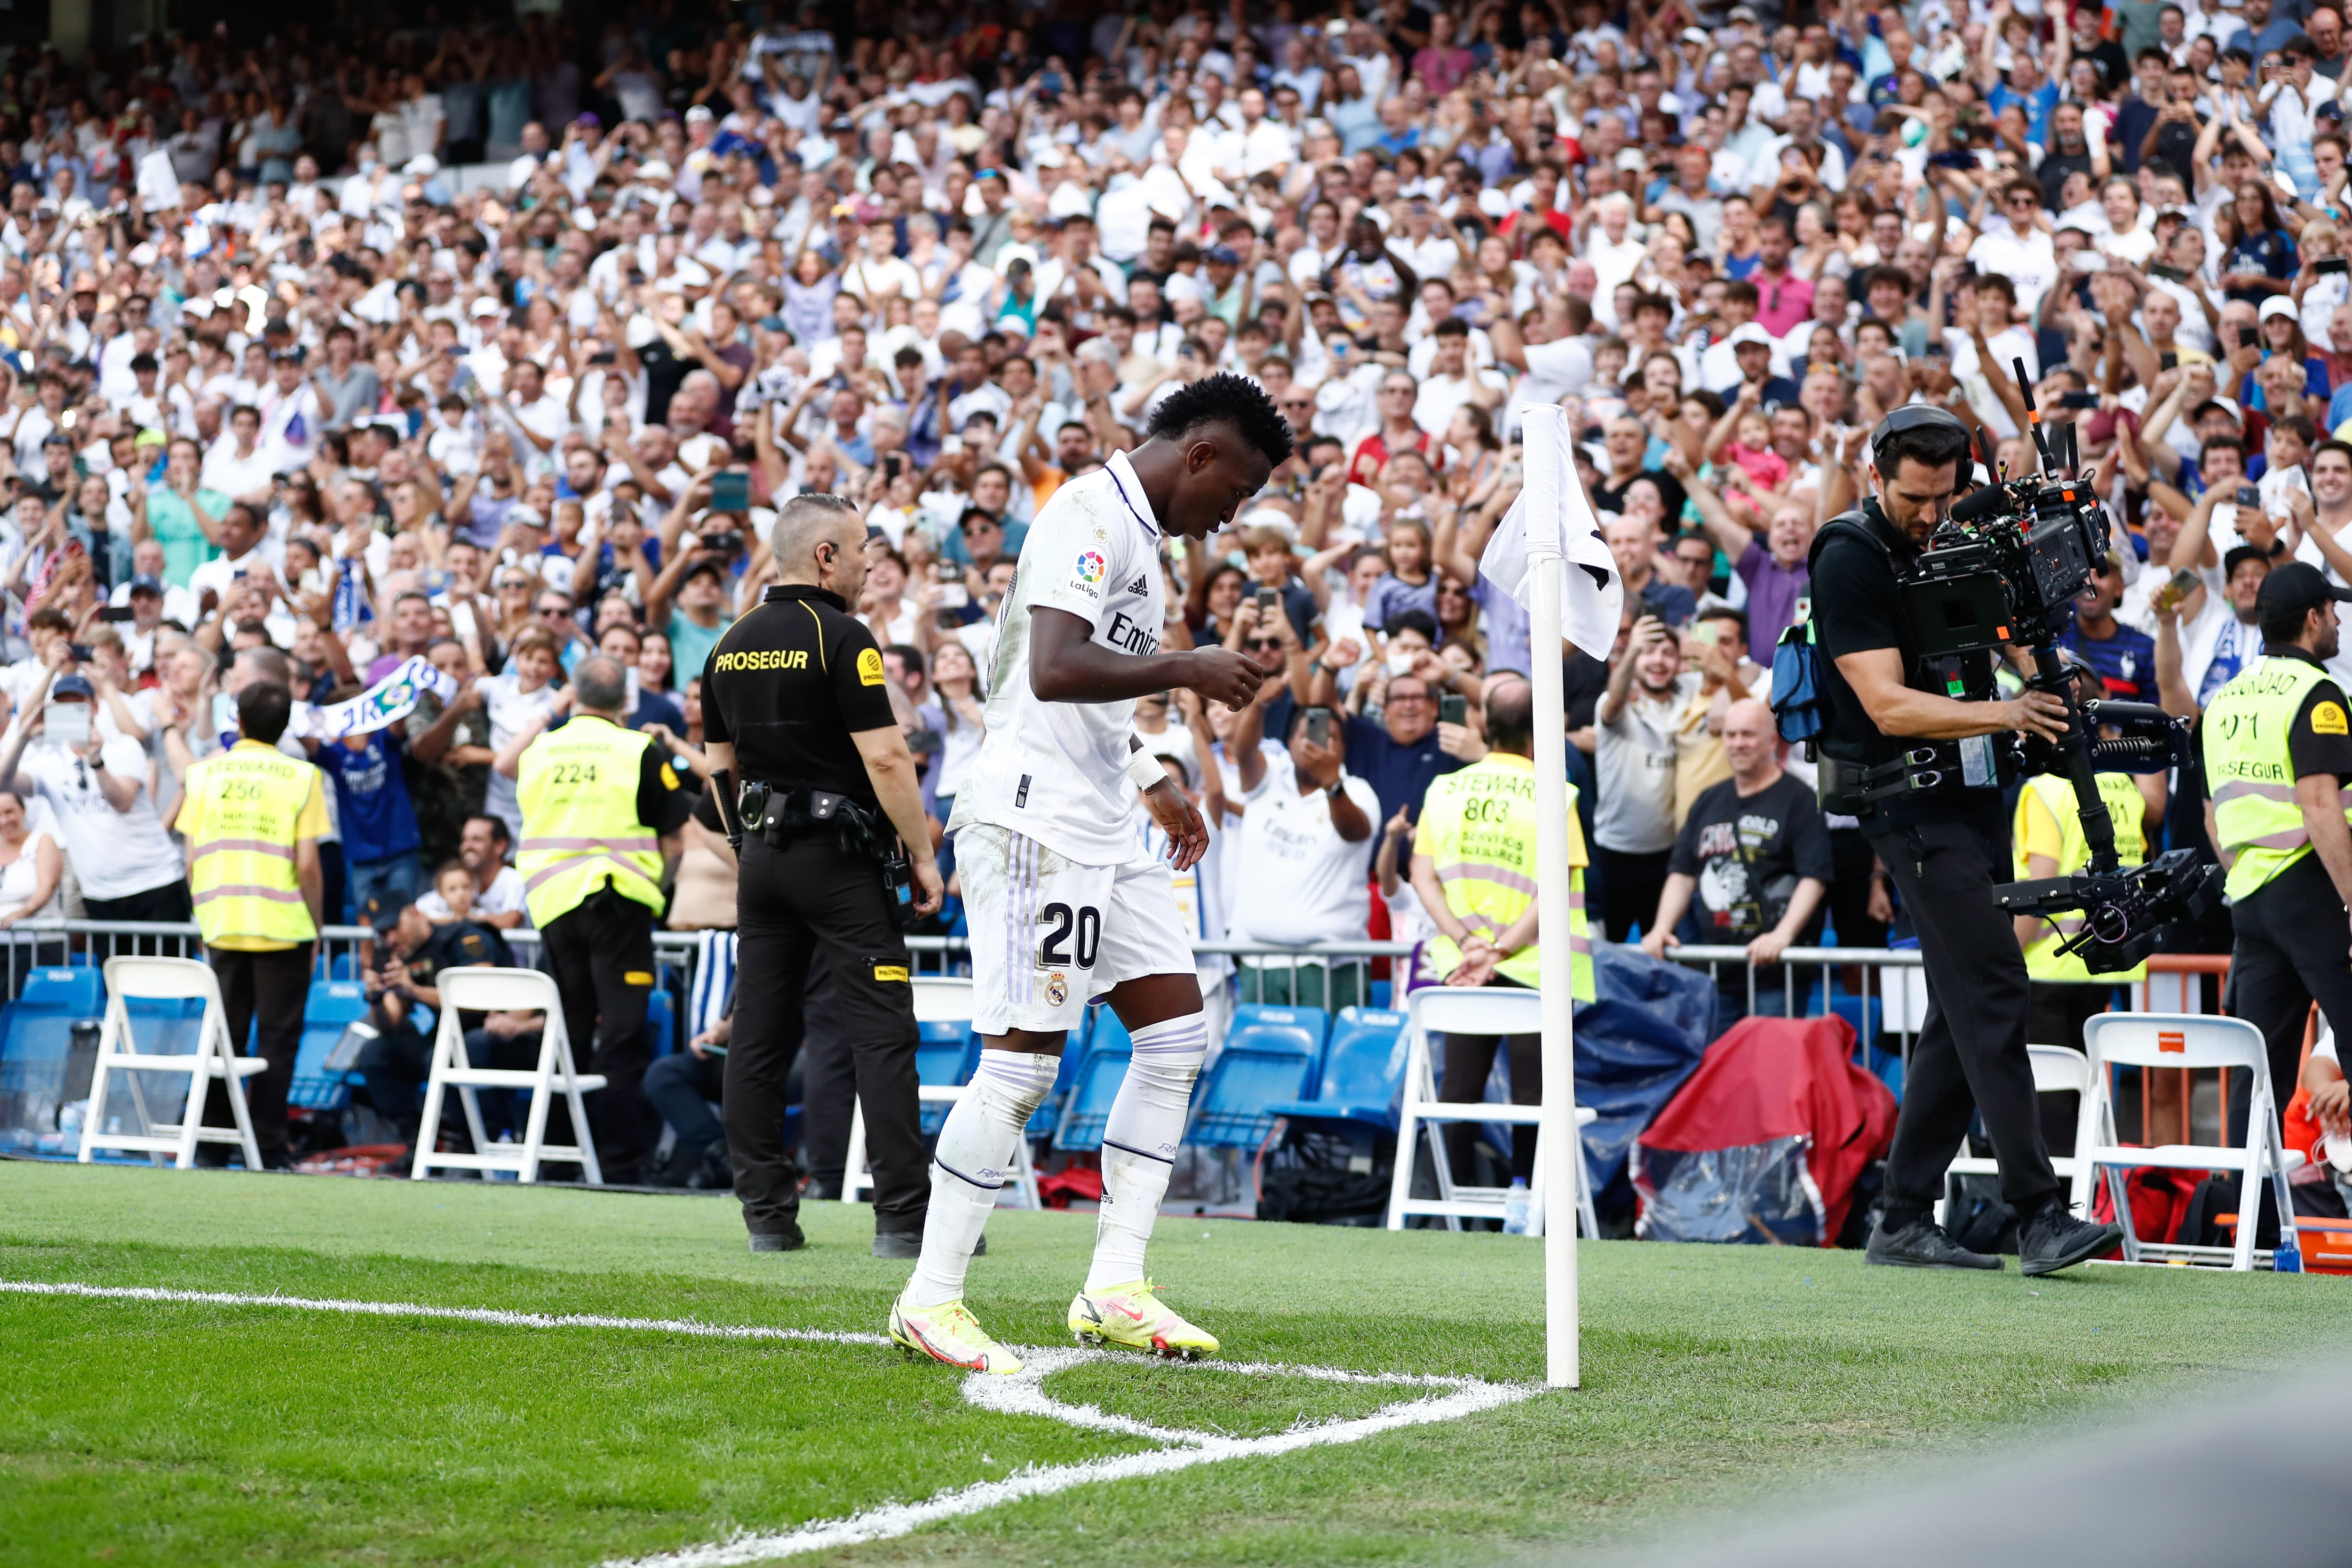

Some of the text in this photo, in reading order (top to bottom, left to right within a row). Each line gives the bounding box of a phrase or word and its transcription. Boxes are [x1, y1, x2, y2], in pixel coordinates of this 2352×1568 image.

[1070, 580, 1098, 599] LaLiga
[715, 650, 809, 674] PROSEGUR
[554, 764, 596, 784] 224
[221, 780, 261, 800] 256
[1446, 773, 1536, 801] STEWAR
[1465, 798, 1509, 823] 803
[1039, 902, 1101, 971] 20
